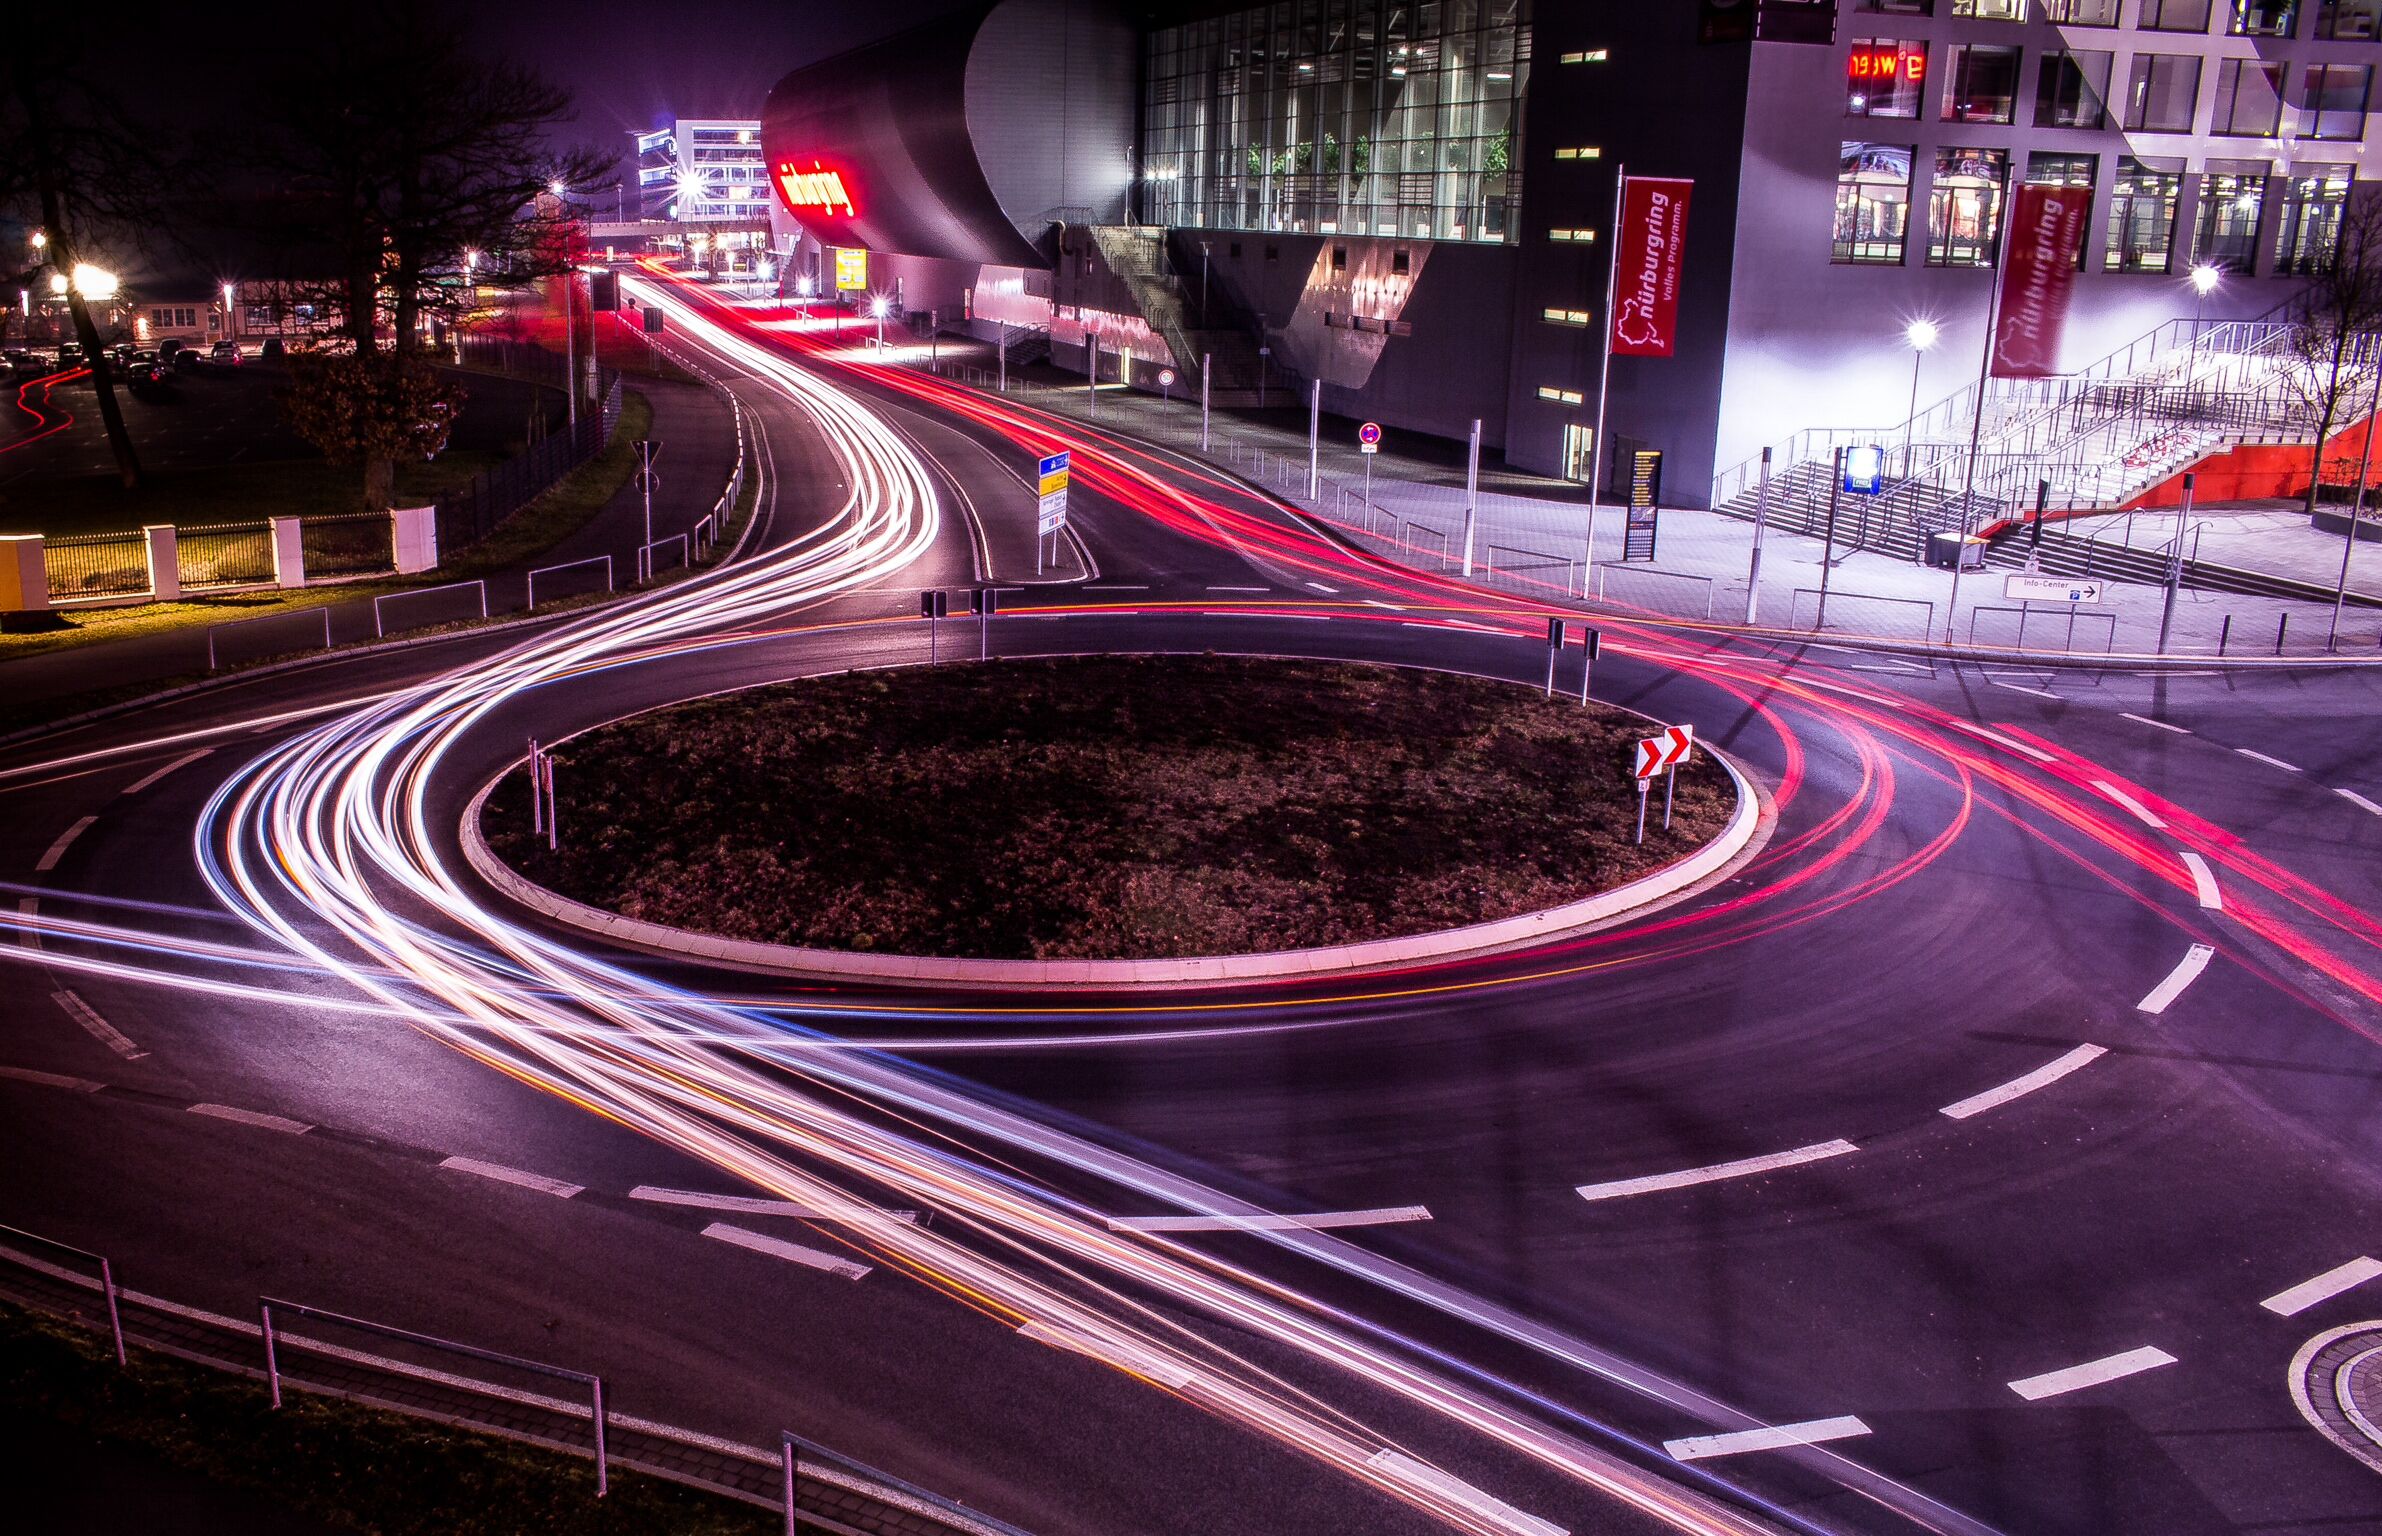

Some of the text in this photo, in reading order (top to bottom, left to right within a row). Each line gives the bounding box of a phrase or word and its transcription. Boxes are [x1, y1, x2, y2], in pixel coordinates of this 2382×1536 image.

[1638, 191, 1669, 319] nürburgring
[1663, 200, 1683, 301] Volles Programm.
[2020, 198, 2063, 340] nürburgring
[2023, 579, 2069, 589] Info-Center
